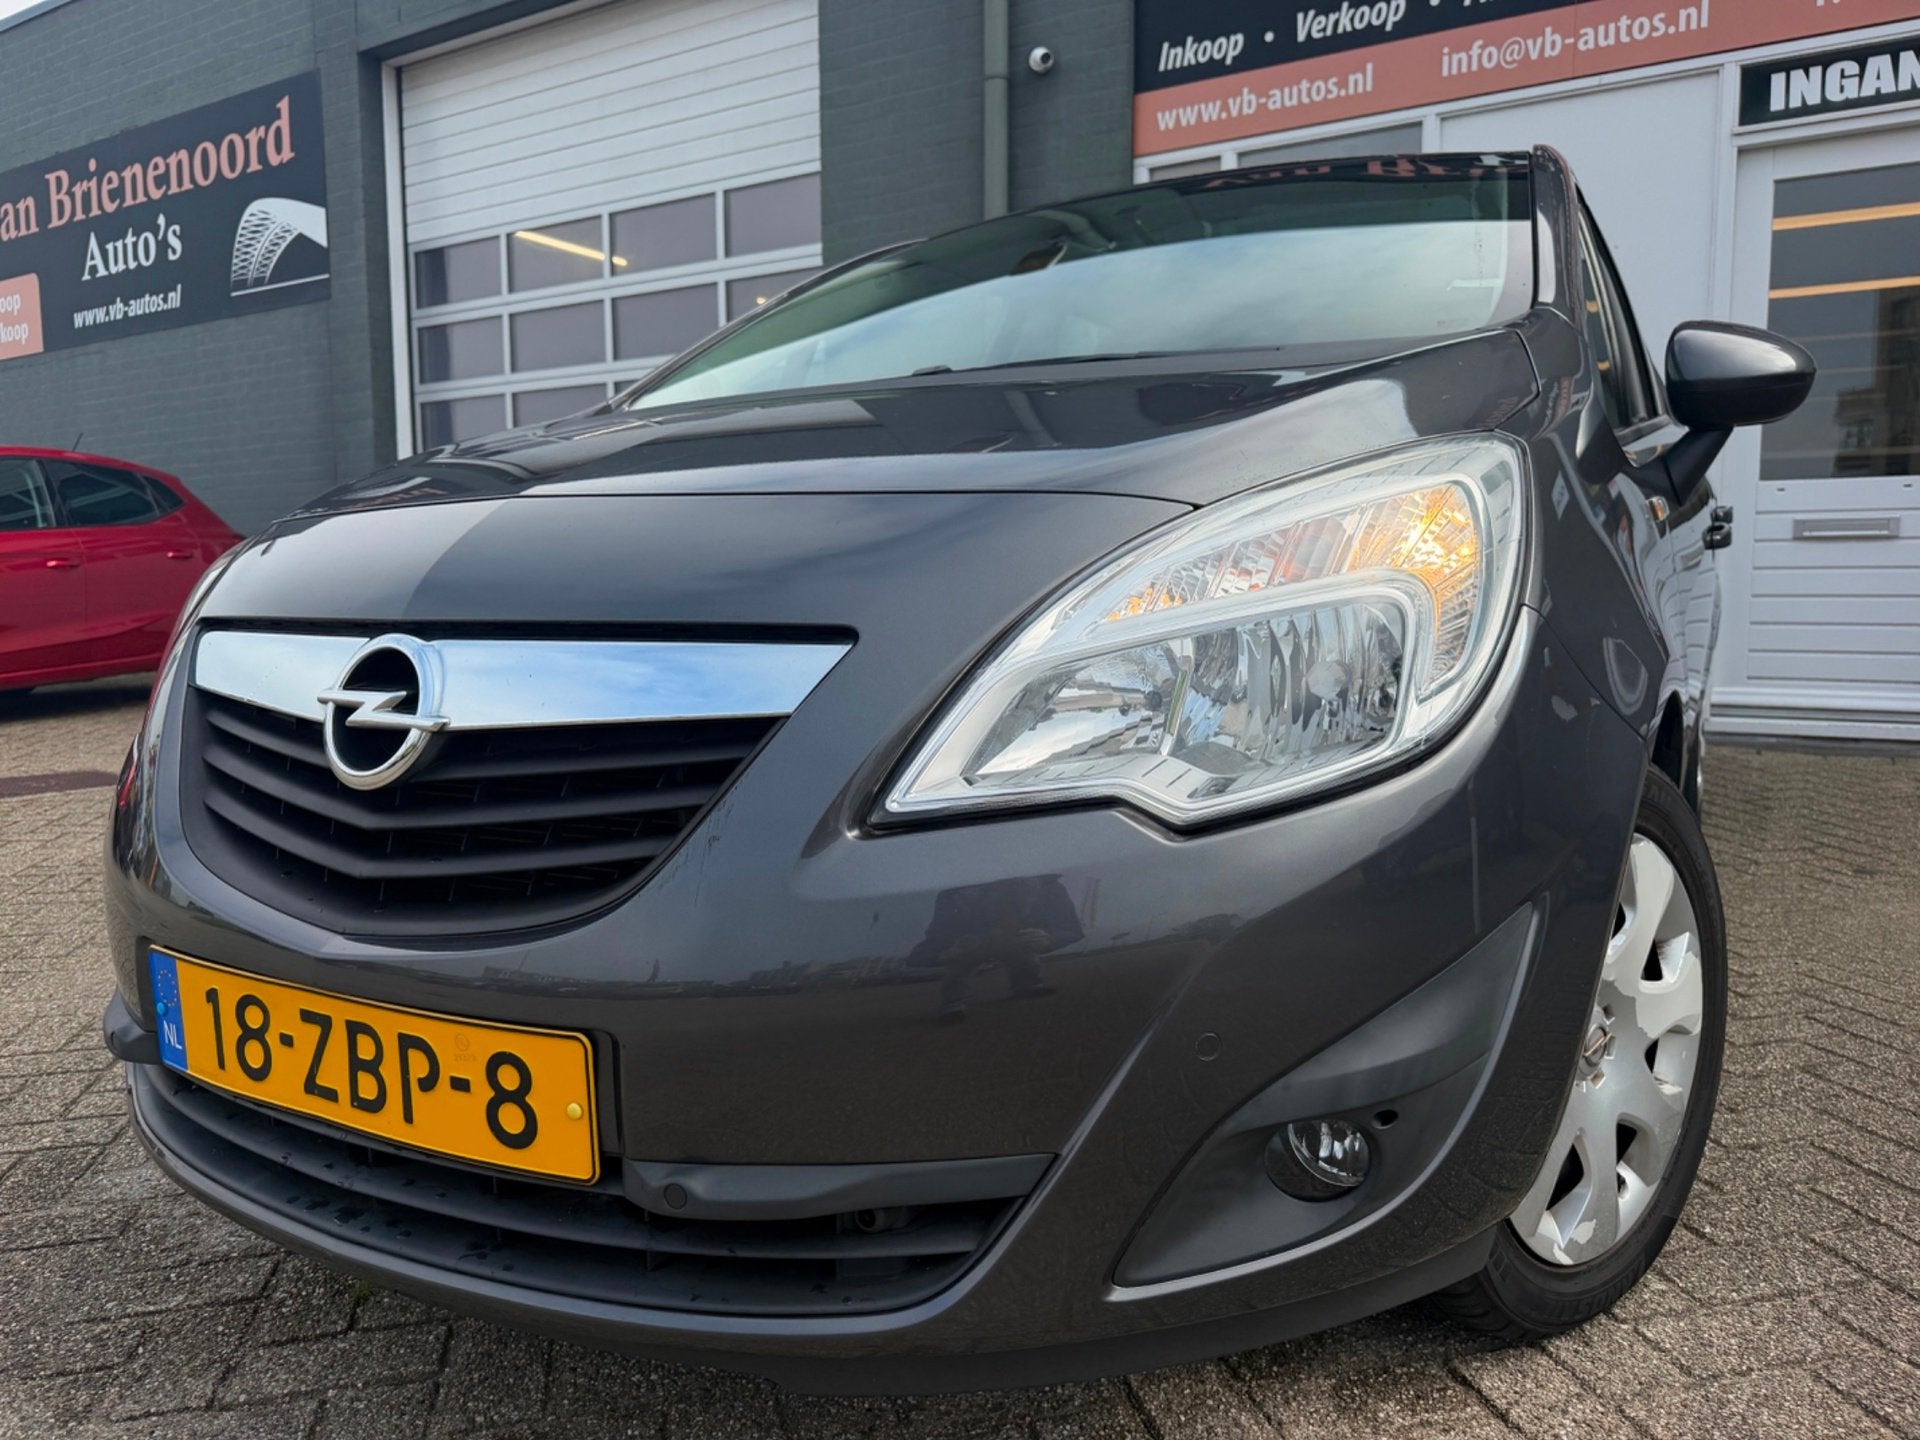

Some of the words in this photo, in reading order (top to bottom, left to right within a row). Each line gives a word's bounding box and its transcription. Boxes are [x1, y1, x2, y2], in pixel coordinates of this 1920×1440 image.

[1158, 32, 1245, 72] Inkoop
[1295, 0, 1406, 42] Verkoop
[1441, 0, 1710, 77] info@vb-autos.nl
[1156, 63, 1374, 132] www.vb-autos.nl
[44, 94, 296, 229] Brienenoord
[81, 212, 183, 282] Auto's
[73, 284, 182, 329] www.vb-autos.nl
[163, 1020, 183, 1050] NL
[204, 986, 539, 1150] 18-ZBP-8
